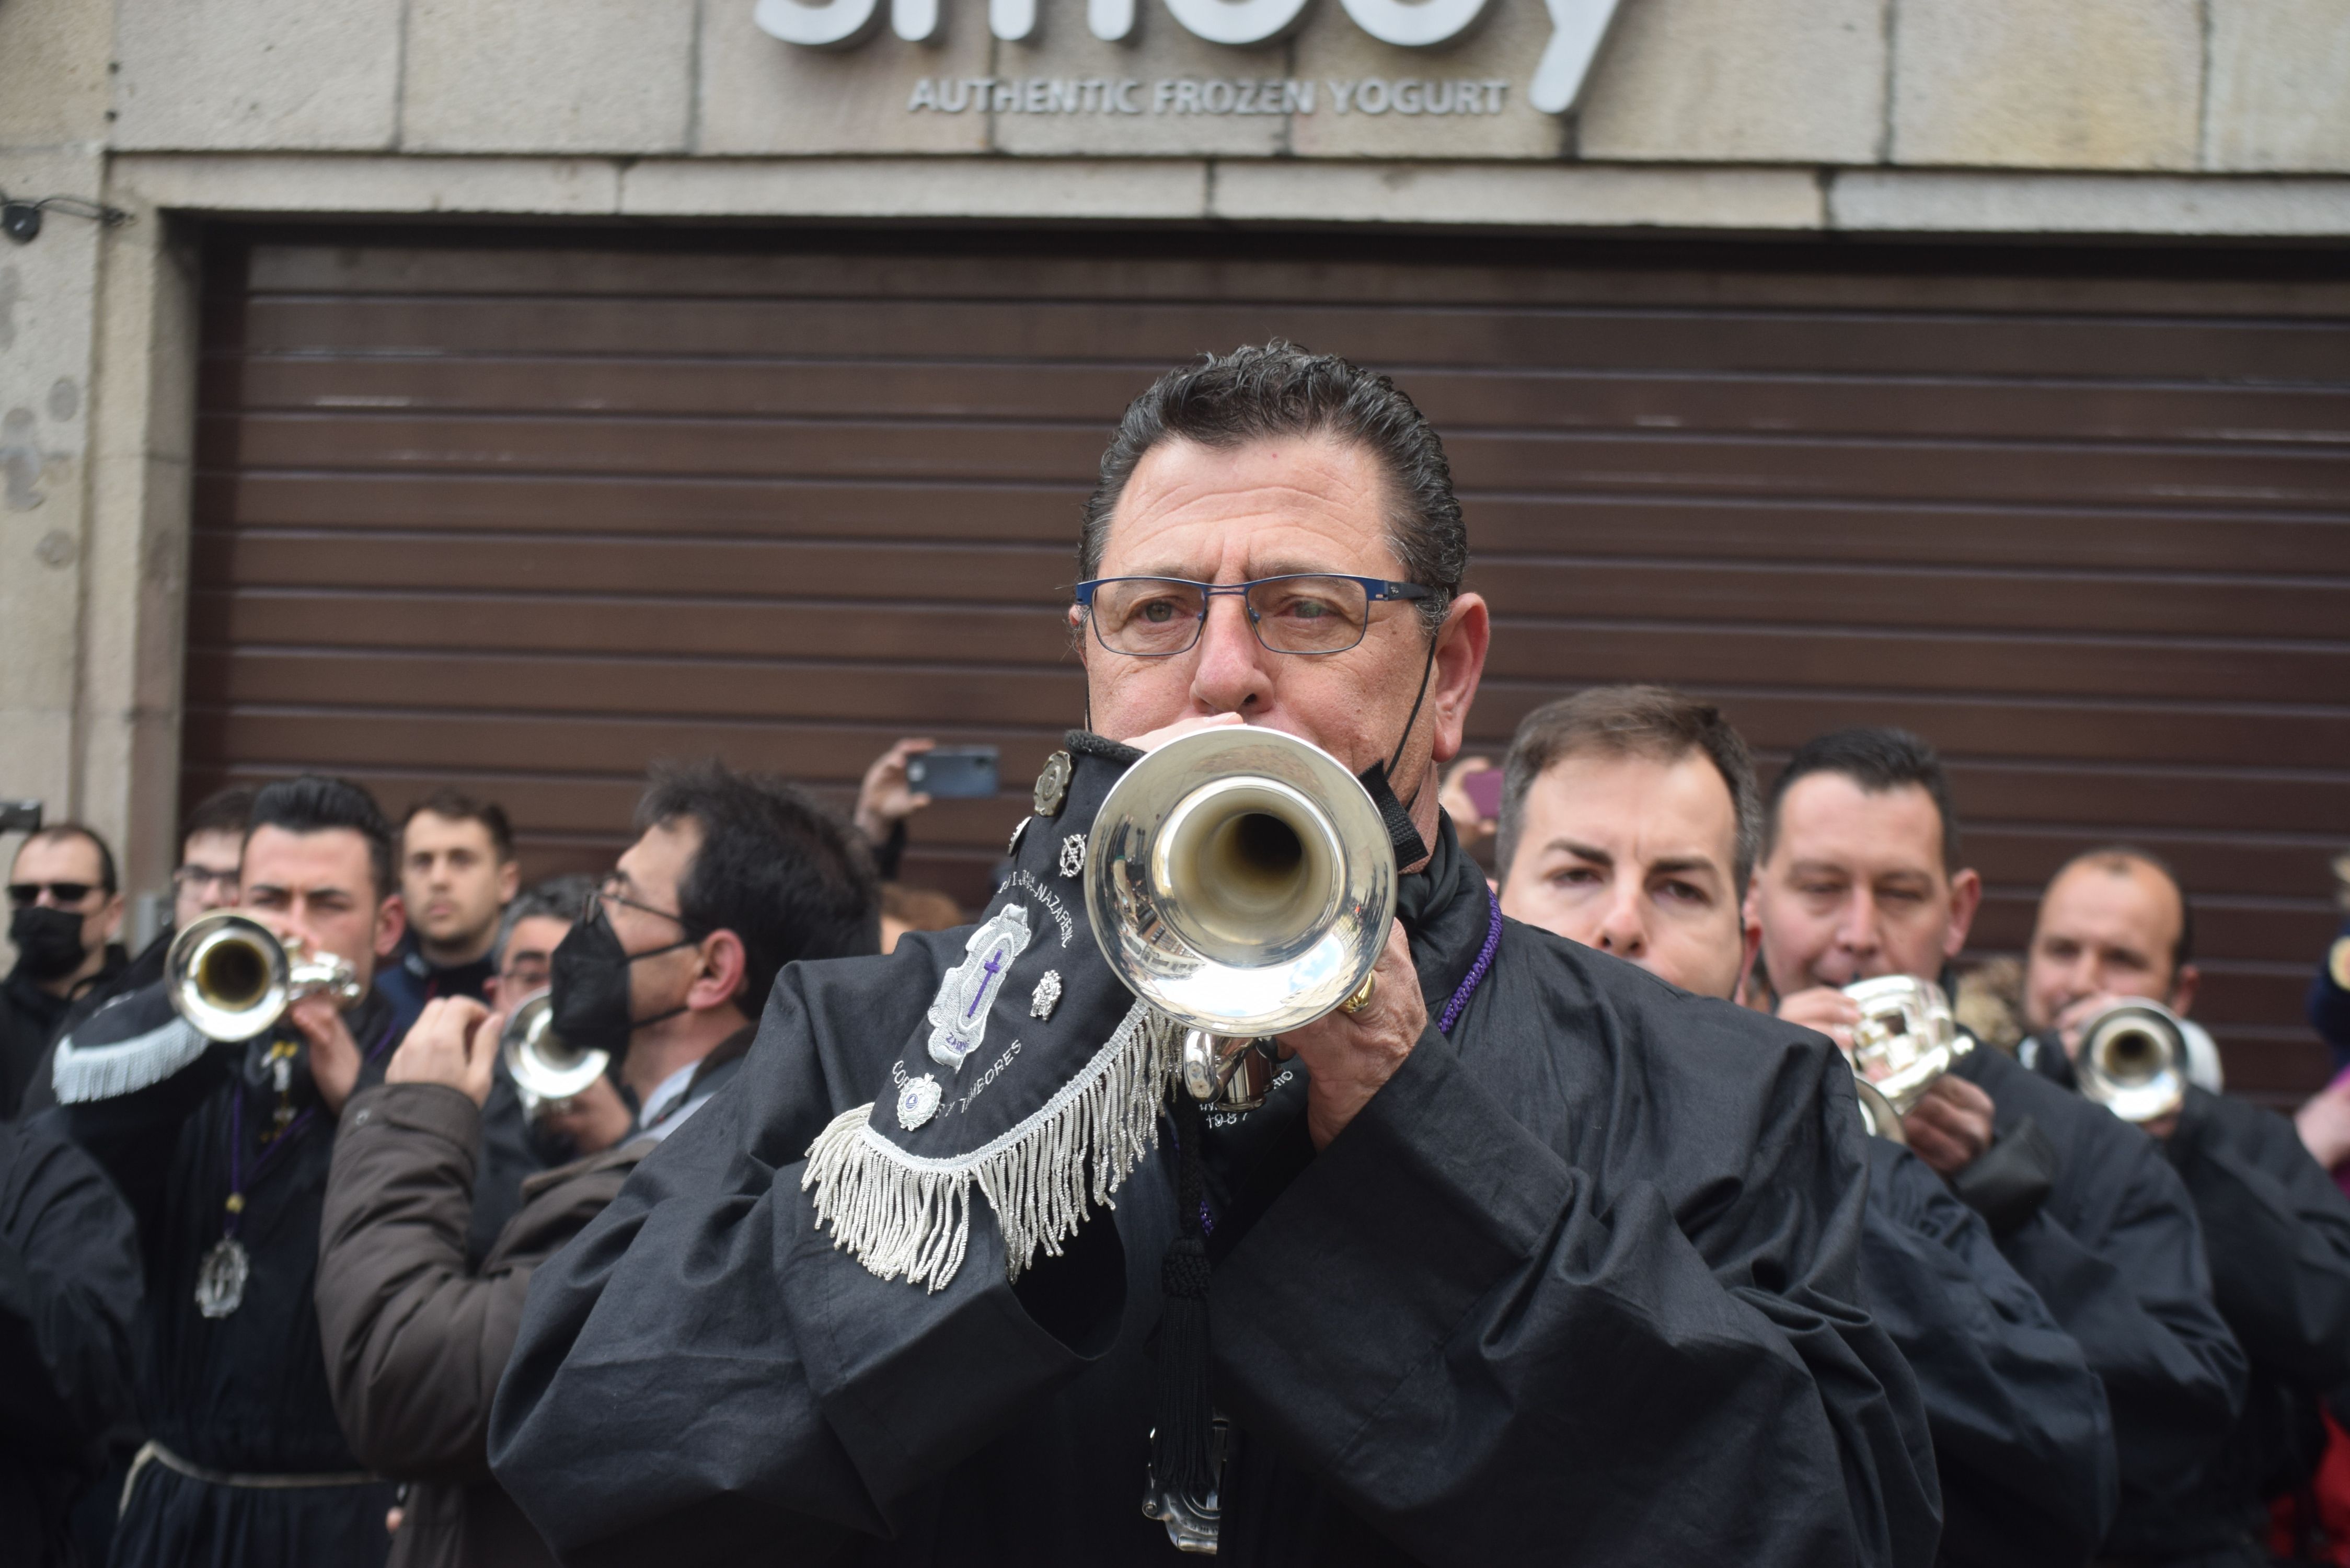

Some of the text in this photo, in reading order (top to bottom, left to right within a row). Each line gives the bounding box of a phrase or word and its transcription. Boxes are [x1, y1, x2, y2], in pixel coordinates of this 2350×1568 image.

[907, 77, 1142, 113] AUTHENTIC
[1153, 78, 1315, 114] FROZEN
[1327, 78, 1508, 114] YOGURT
